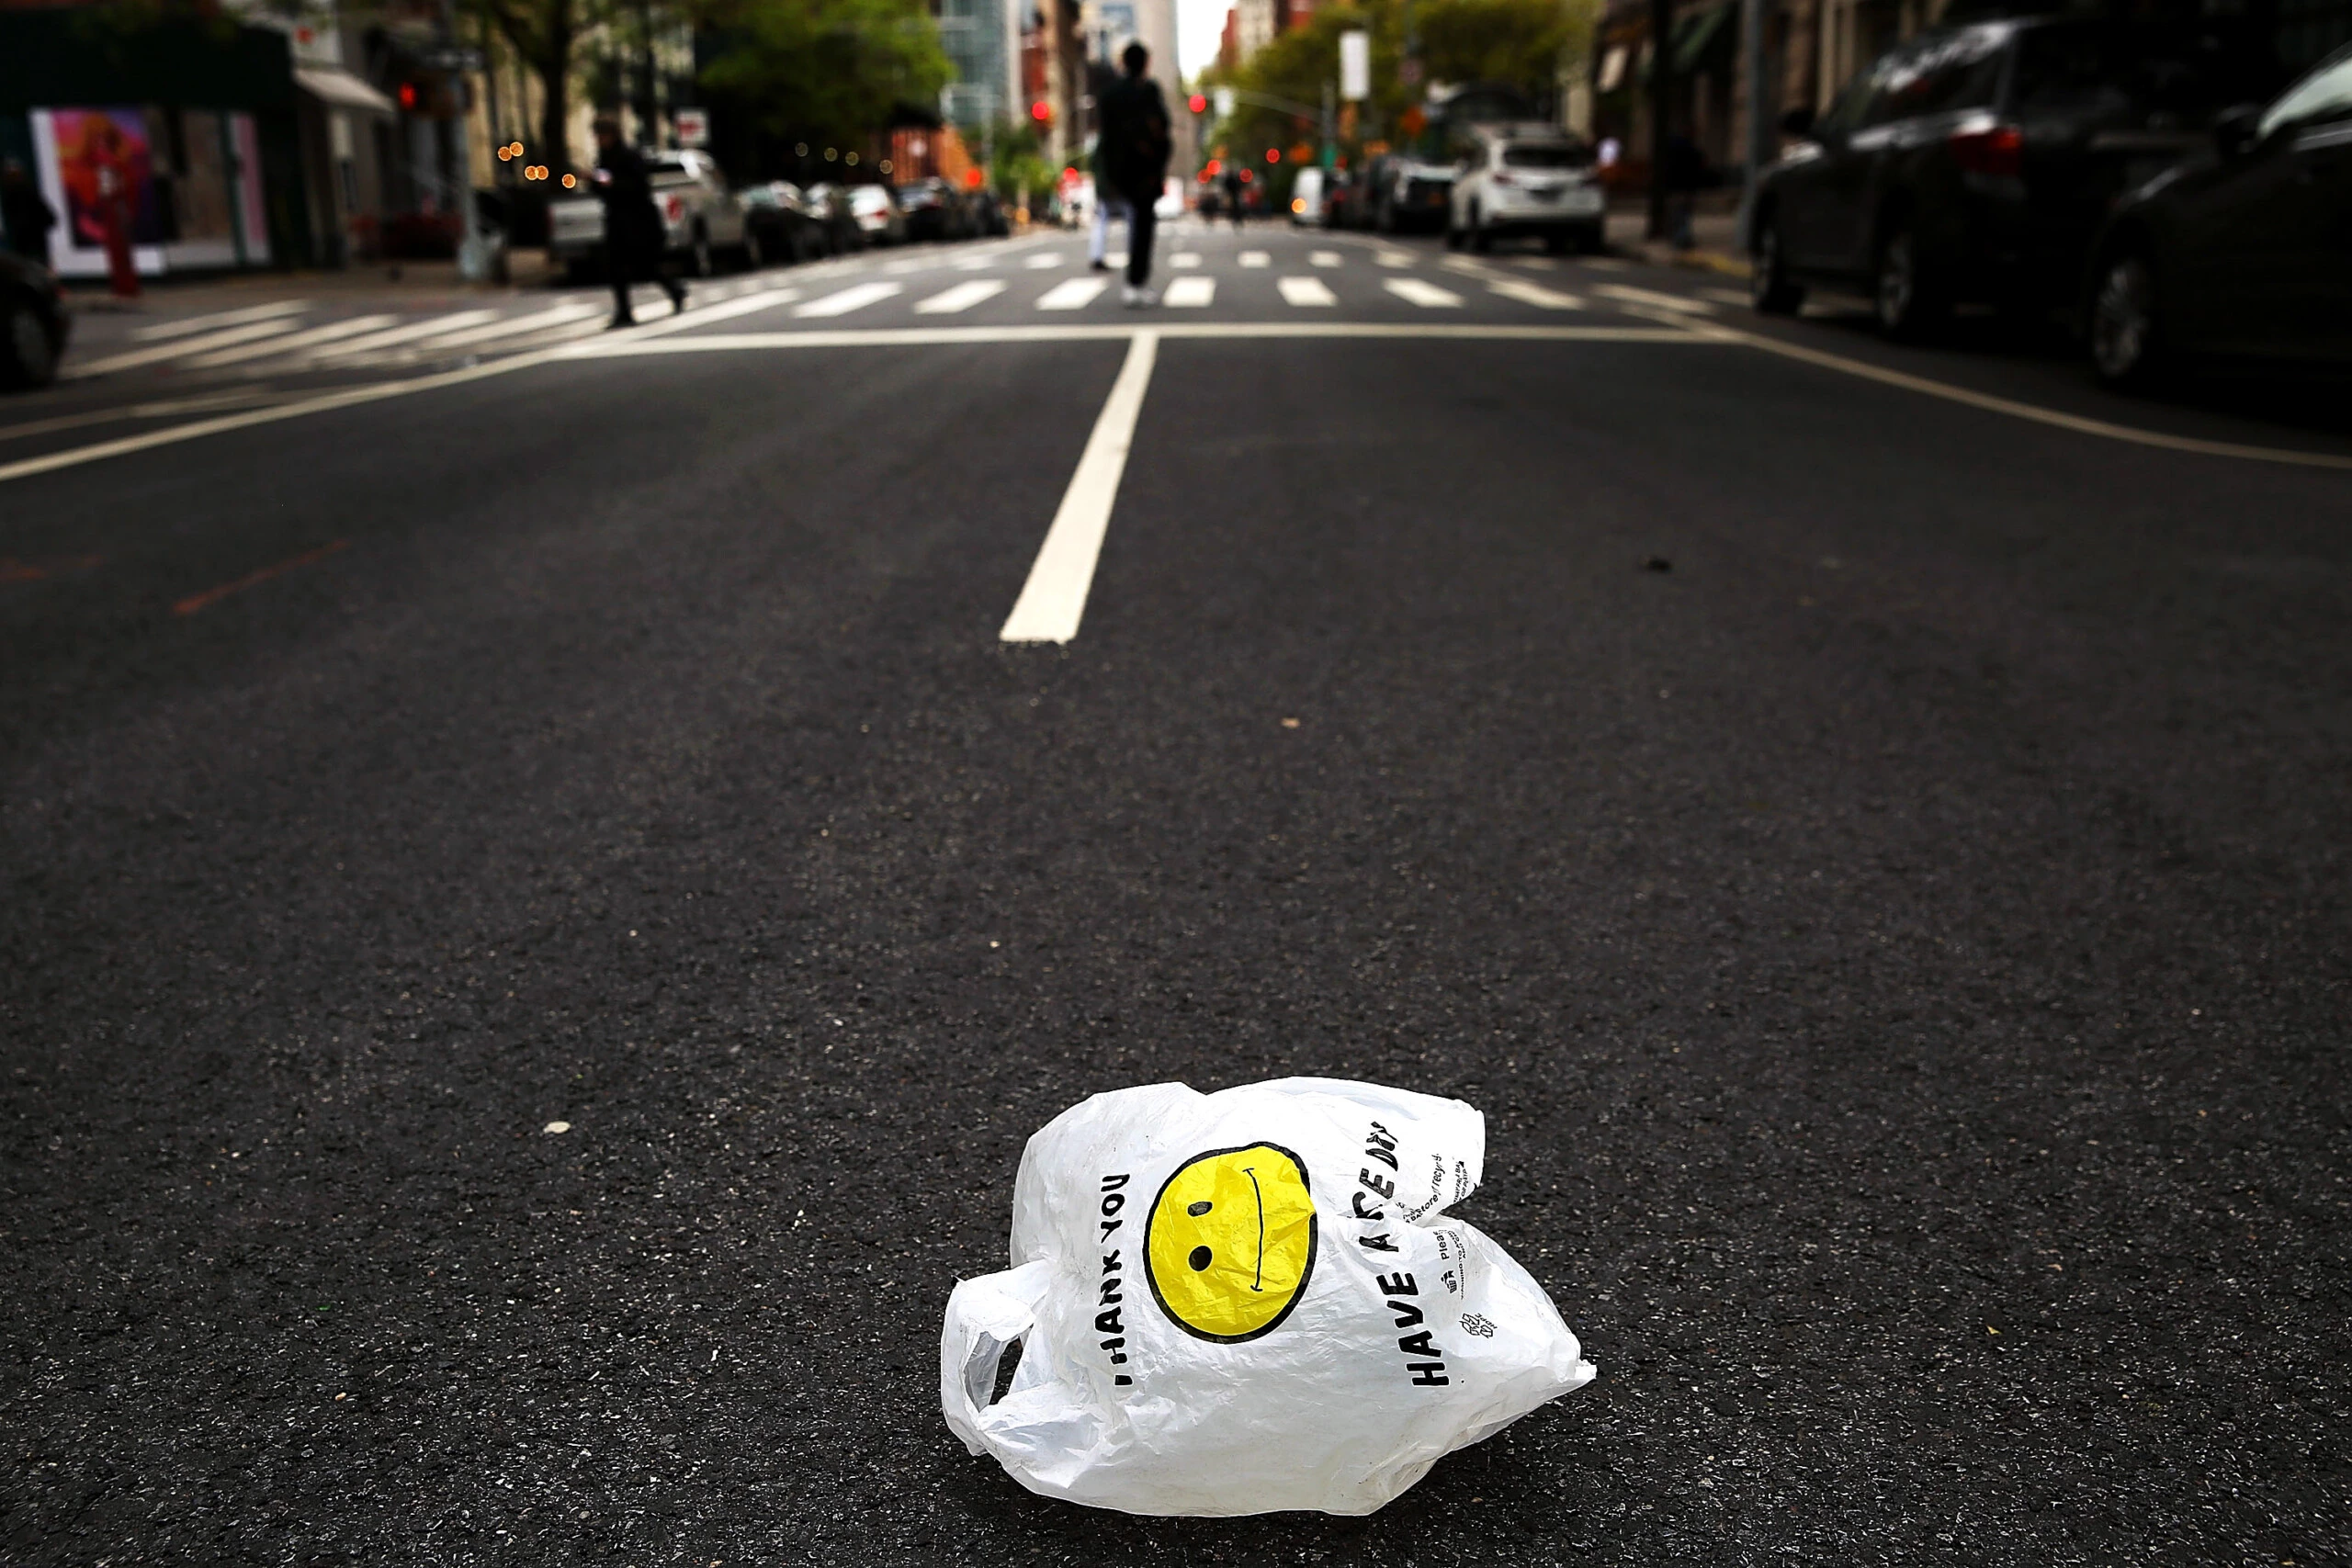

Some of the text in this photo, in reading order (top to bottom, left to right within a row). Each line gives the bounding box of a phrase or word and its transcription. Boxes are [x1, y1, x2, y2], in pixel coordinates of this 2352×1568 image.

[1101, 1174, 1130, 1244] YOU
[1359, 1234, 1399, 1252] A
[1375, 1272, 1450, 1387] HAVE
